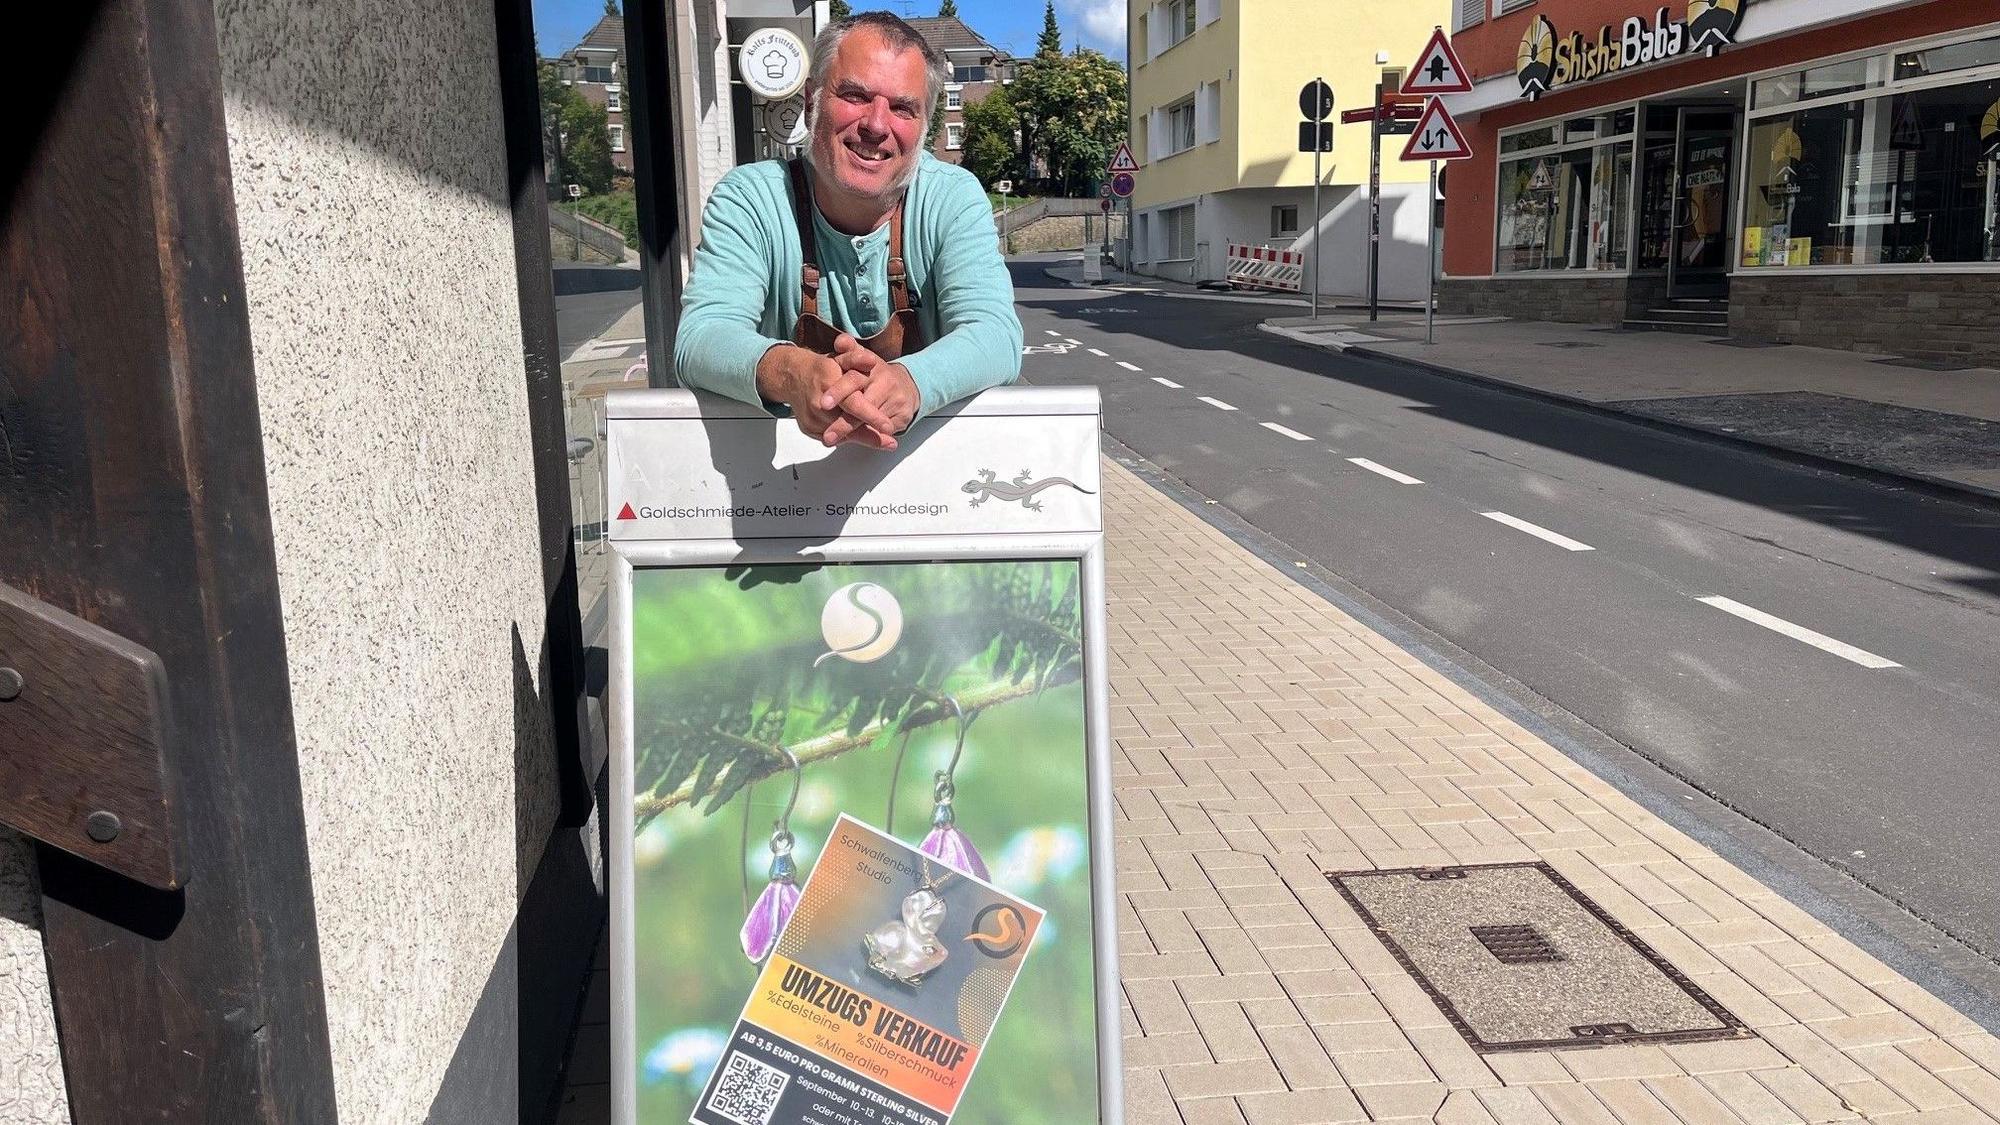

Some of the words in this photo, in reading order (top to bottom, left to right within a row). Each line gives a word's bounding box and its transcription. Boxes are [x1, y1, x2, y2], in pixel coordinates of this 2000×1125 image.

[639, 504, 812, 519] Goldschmiede-Atelier
[825, 502, 949, 517] Schmuckdesign
[840, 834, 923, 884] Schwalfenberg
[856, 861, 892, 885] Studio
[768, 990, 840, 1033] %Edelsteine
[857, 1032, 957, 1089] %Silberschmuck
[781, 964, 873, 1027] UMZUGS
[873, 1007, 969, 1072] VERKAUF
[740, 1031, 757, 1044] AB
[772, 1045, 799, 1064] EURO
[799, 1058, 821, 1074] PRO
[821, 1069, 860, 1093] GRAMM
[860, 1087, 905, 1114] STERLING
[815, 1034, 889, 1079] %Mineralien
[796, 1075, 847, 1105] September
[812, 1103, 835, 1117] oder
[834, 1113, 851, 1125] mit
